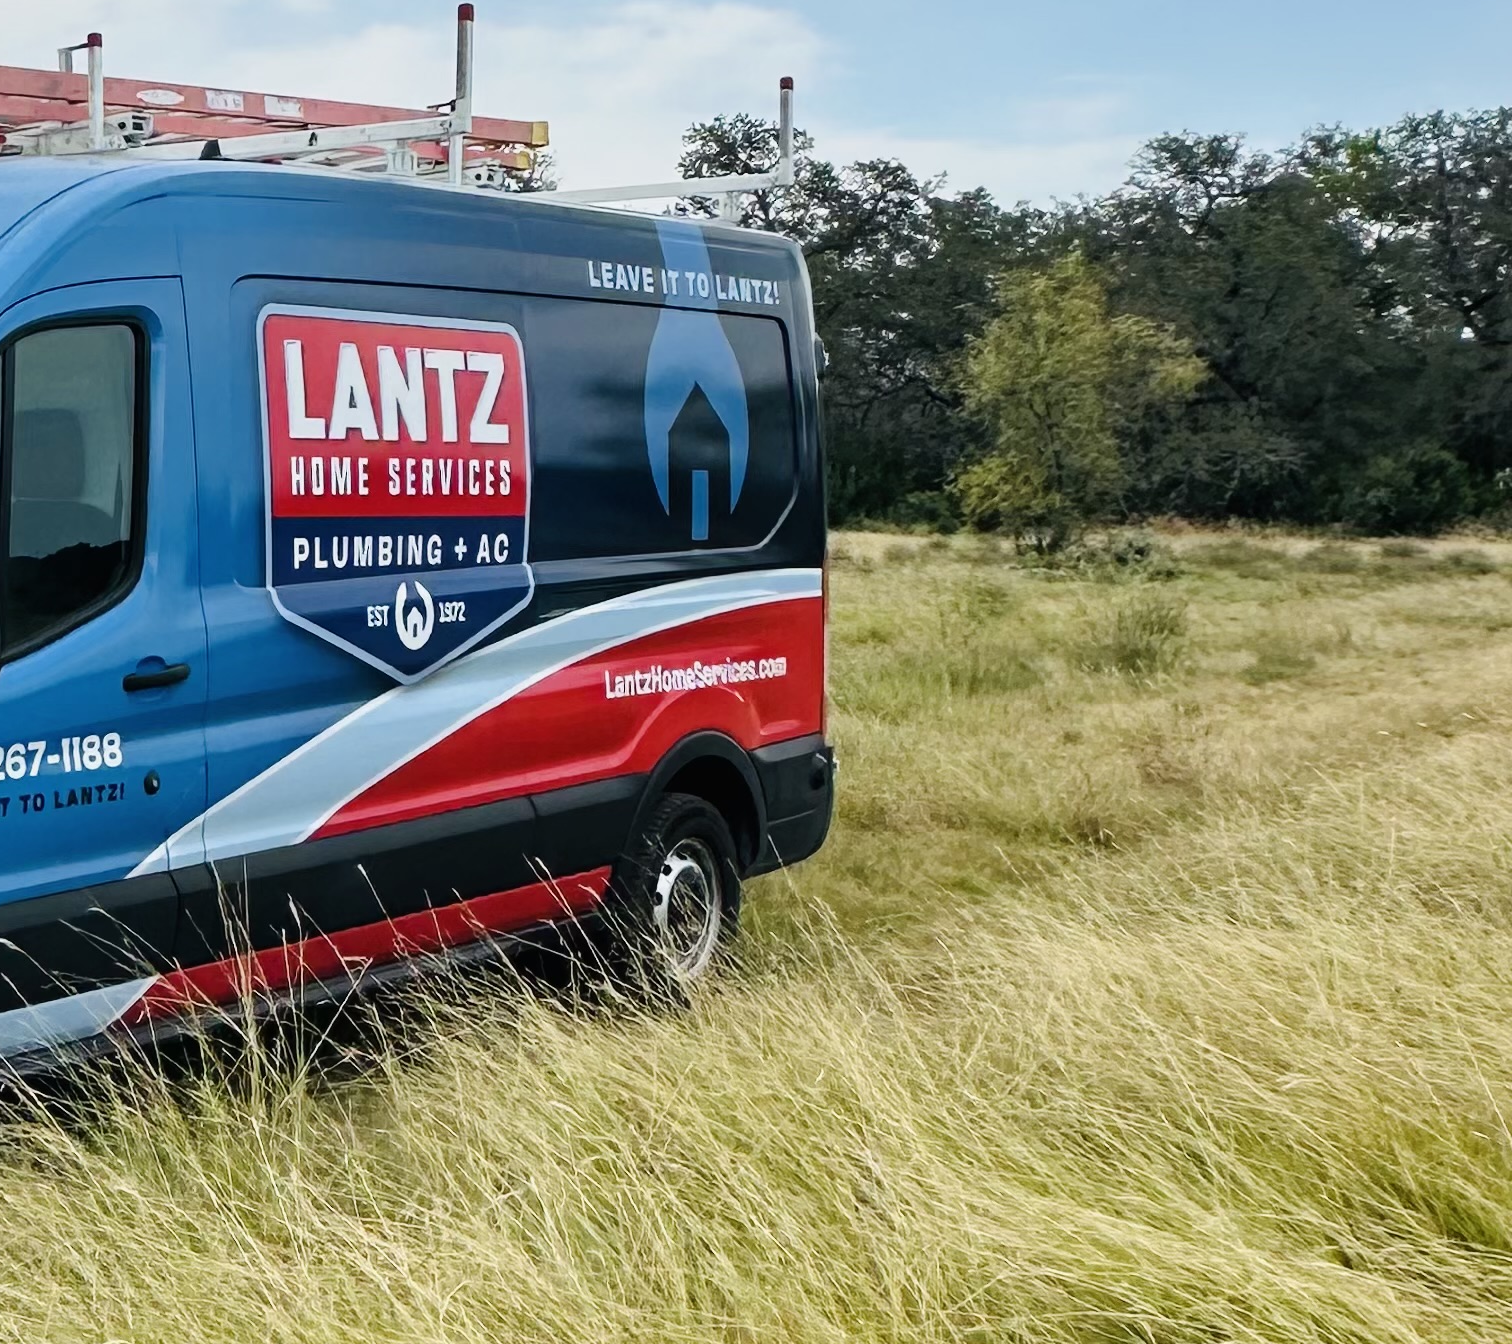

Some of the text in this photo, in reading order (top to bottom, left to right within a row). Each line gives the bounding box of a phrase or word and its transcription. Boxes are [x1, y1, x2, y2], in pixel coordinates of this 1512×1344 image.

[588, 260, 780, 305] LEAVE IT TO LANTZ!
[284, 339, 510, 443] LANTZ
[291, 456, 511, 496] HOME SERVICES
[293, 534, 443, 570] PLUMBING
[476, 533, 510, 564] AC
[367, 605, 390, 627] EST
[604, 656, 787, 699] LantzHomeServices.com
[19, 793, 46, 815] TO
[54, 782, 125, 809] LANTZ!
